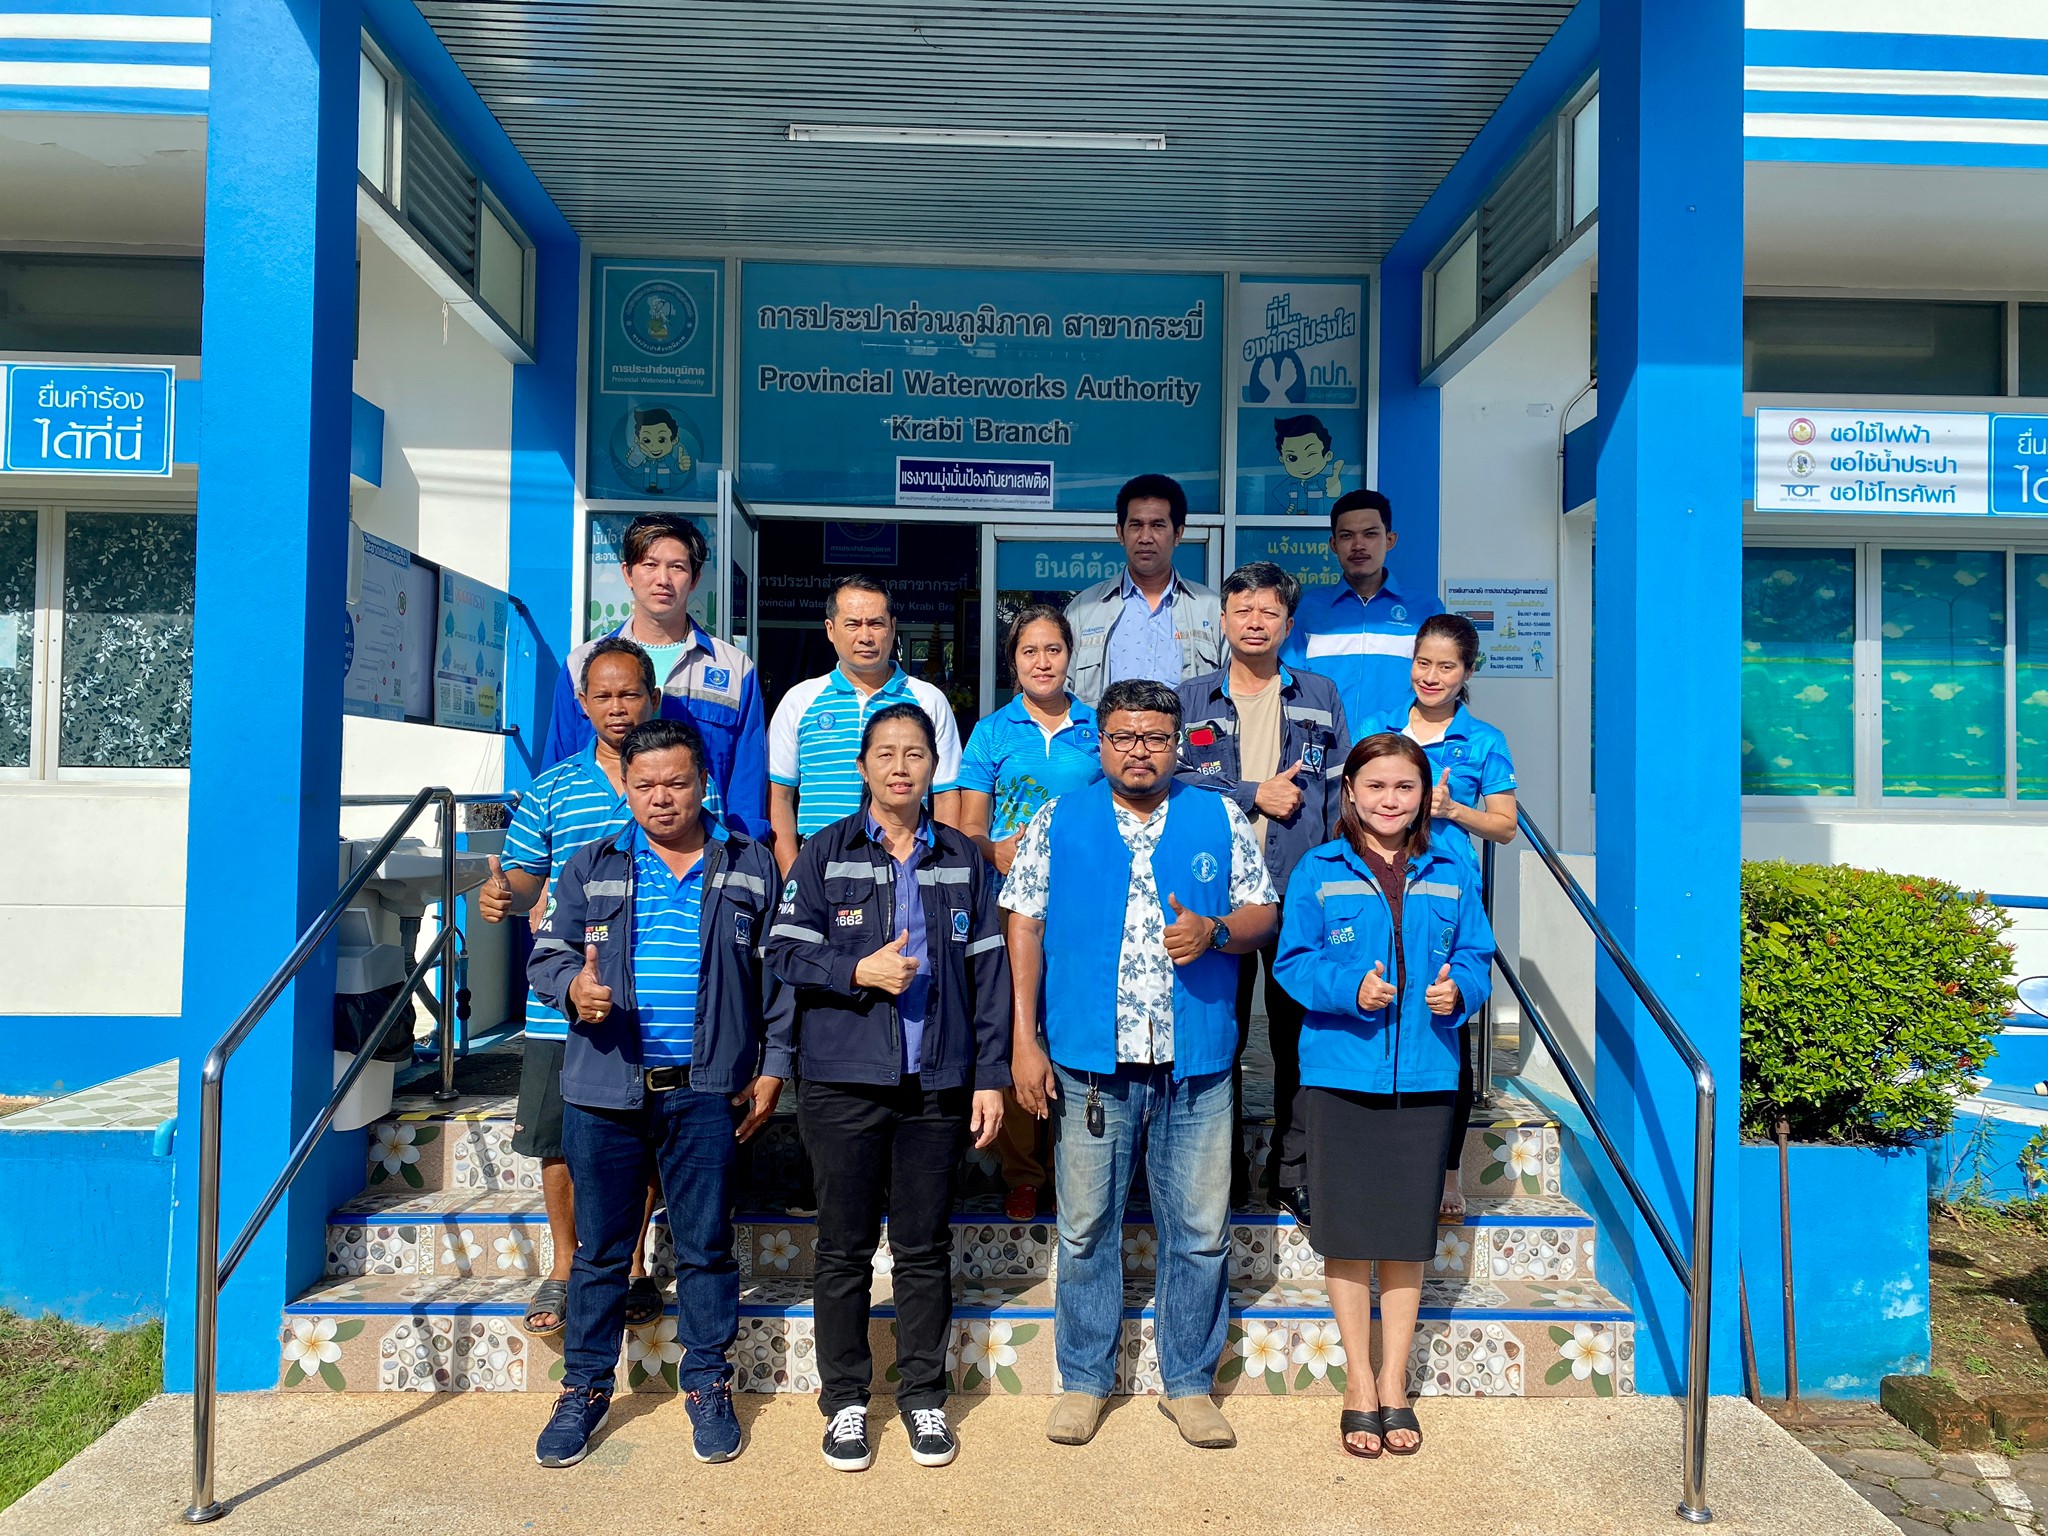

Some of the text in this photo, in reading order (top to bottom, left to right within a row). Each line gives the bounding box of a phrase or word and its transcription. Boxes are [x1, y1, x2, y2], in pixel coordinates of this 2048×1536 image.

[758, 300, 1204, 346] การประปาส่วนภูมิภาค สาขากระบี่
[1243, 307, 1356, 361] องค์กรโปร่งใส
[612, 364, 705, 377] การประปาส่วนภูมิภาค
[38, 380, 144, 409] ยื่นคำร้อง
[758, 365, 1201, 407] Provincial Waterworks Authority
[33, 415, 143, 461] ได้ที่นี่
[890, 415, 1071, 444] Krabi Branch
[1830, 420, 1931, 443] ขอใช้ไฟฟ้า
[2017, 428, 2048, 455] ยื่น
[1830, 449, 1957, 474] ขอใช้น้ำประปา
[1780, 484, 1821, 497] TOT
[1830, 480, 1957, 503] ขอใช้โทรศัพท์
[835, 914, 863, 927] 1662
[585, 931, 609, 943] 662
[1327, 932, 1356, 945] 1662
